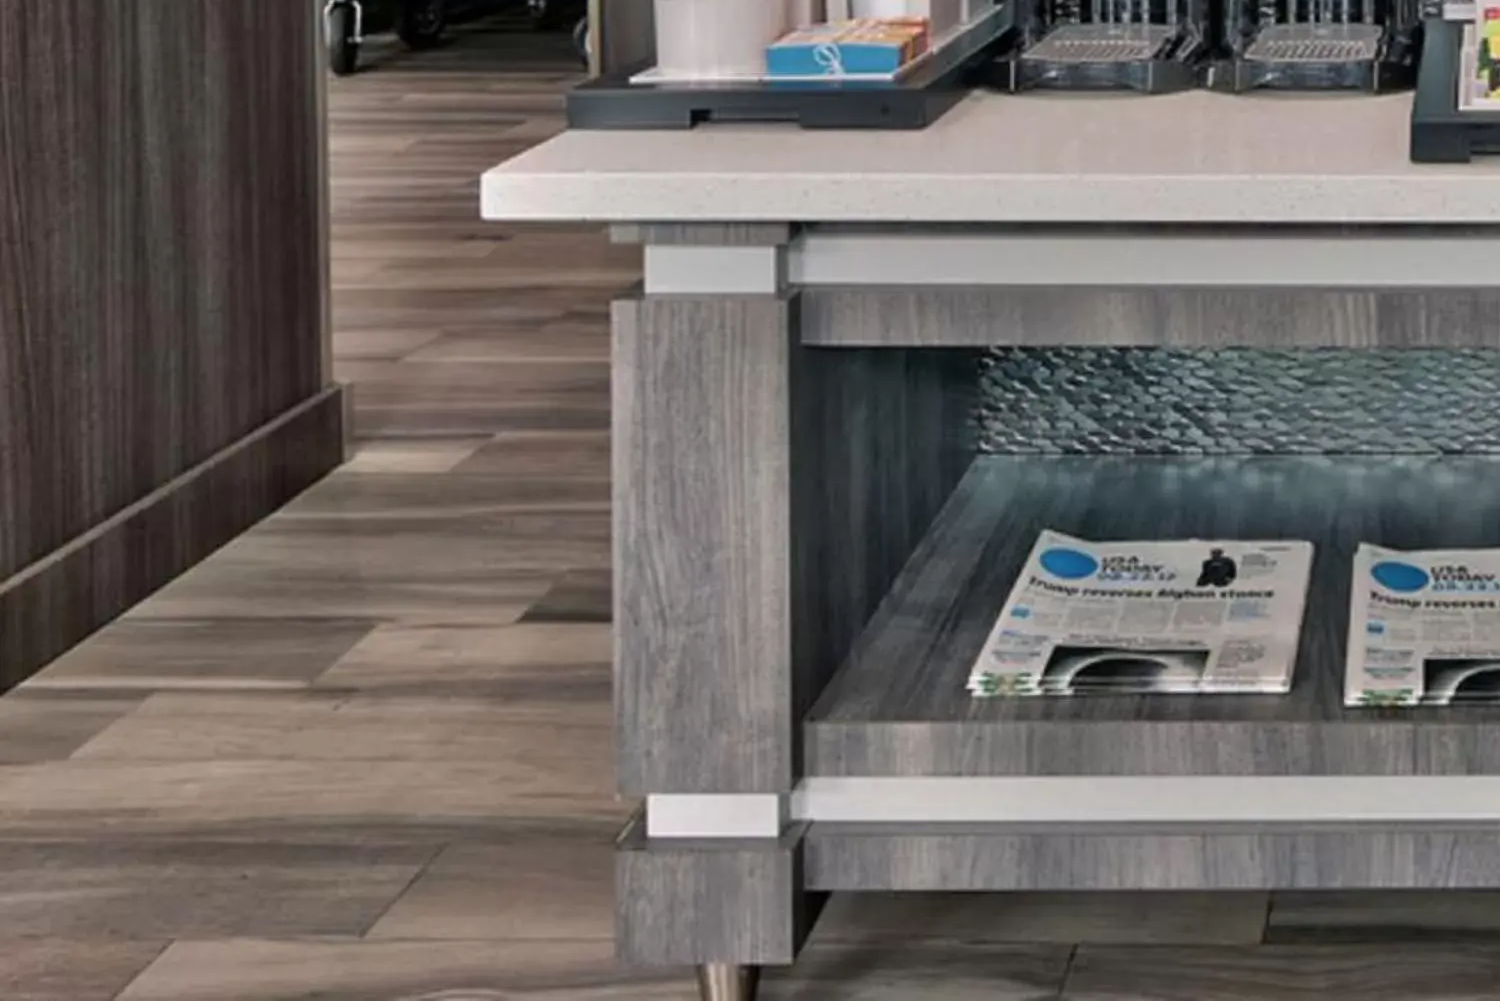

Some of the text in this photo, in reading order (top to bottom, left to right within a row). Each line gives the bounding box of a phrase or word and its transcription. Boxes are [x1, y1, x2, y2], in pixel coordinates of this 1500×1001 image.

[1028, 576, 1080, 597] Trump
[1082, 588, 1153, 599] reverses
[1369, 591, 1422, 609] Trump
[1425, 599, 1496, 609] reverses
